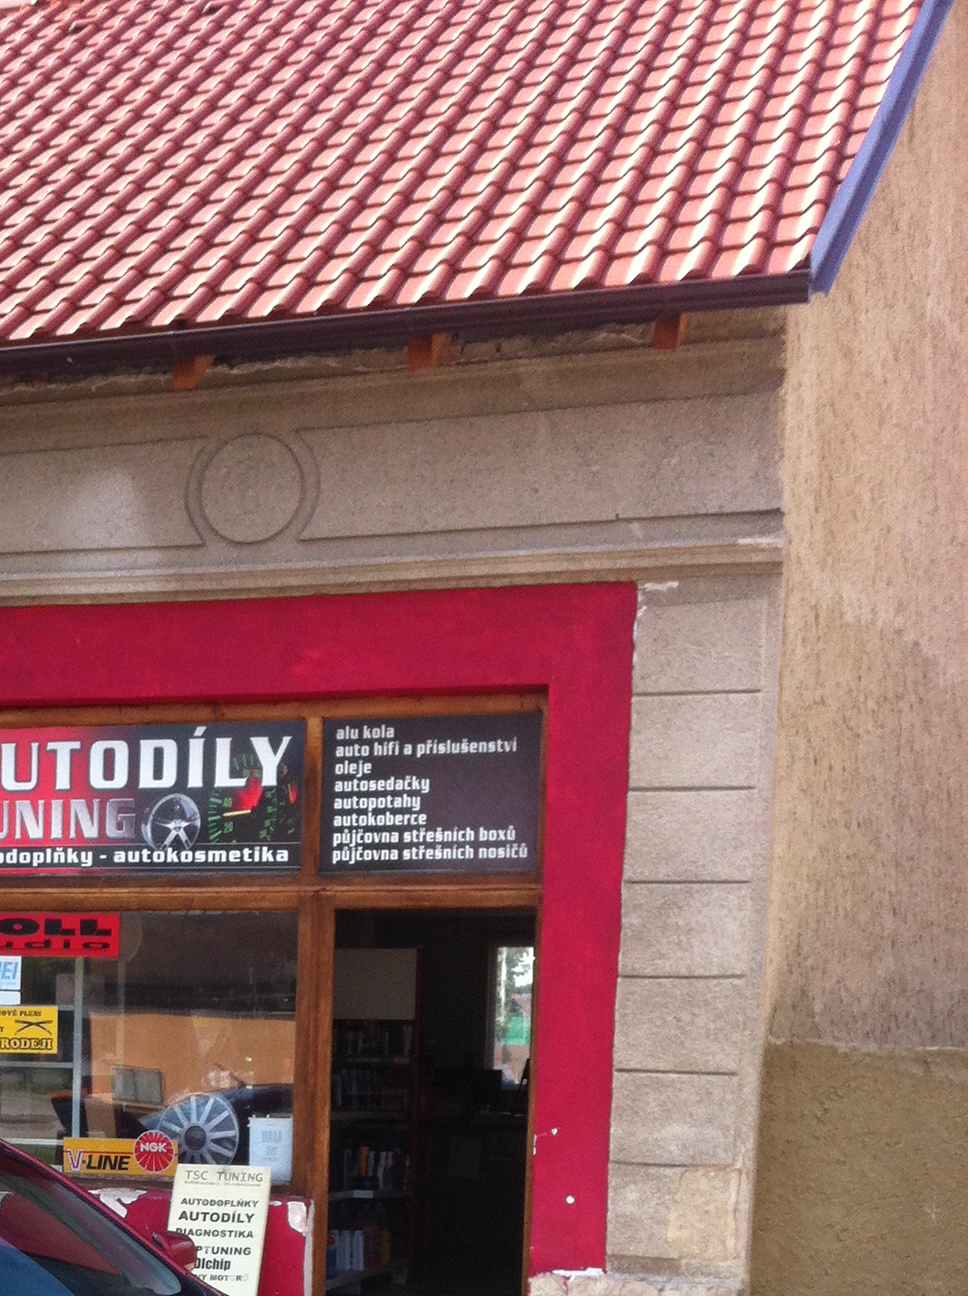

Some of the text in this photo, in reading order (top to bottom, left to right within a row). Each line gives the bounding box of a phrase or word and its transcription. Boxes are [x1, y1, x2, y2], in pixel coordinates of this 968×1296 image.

[336, 725, 395, 740] alu kola
[335, 737, 517, 757] auto hifi a příslušenství
[335, 760, 372, 777] oleje
[334, 776, 430, 793] autosedačky
[334, 794, 421, 811] autopotahy
[333, 812, 427, 827] autokoberce
[333, 825, 516, 847] půjčovna střešních boxů
[113, 845, 289, 864] autokosmetika
[332, 843, 528, 865] půjčovna střešních nosičů
[140, 1142, 167, 1153] NGK
[186, 1170, 263, 1183] TSC TUNING
[178, 1210, 255, 1224] AUTODÍLY
